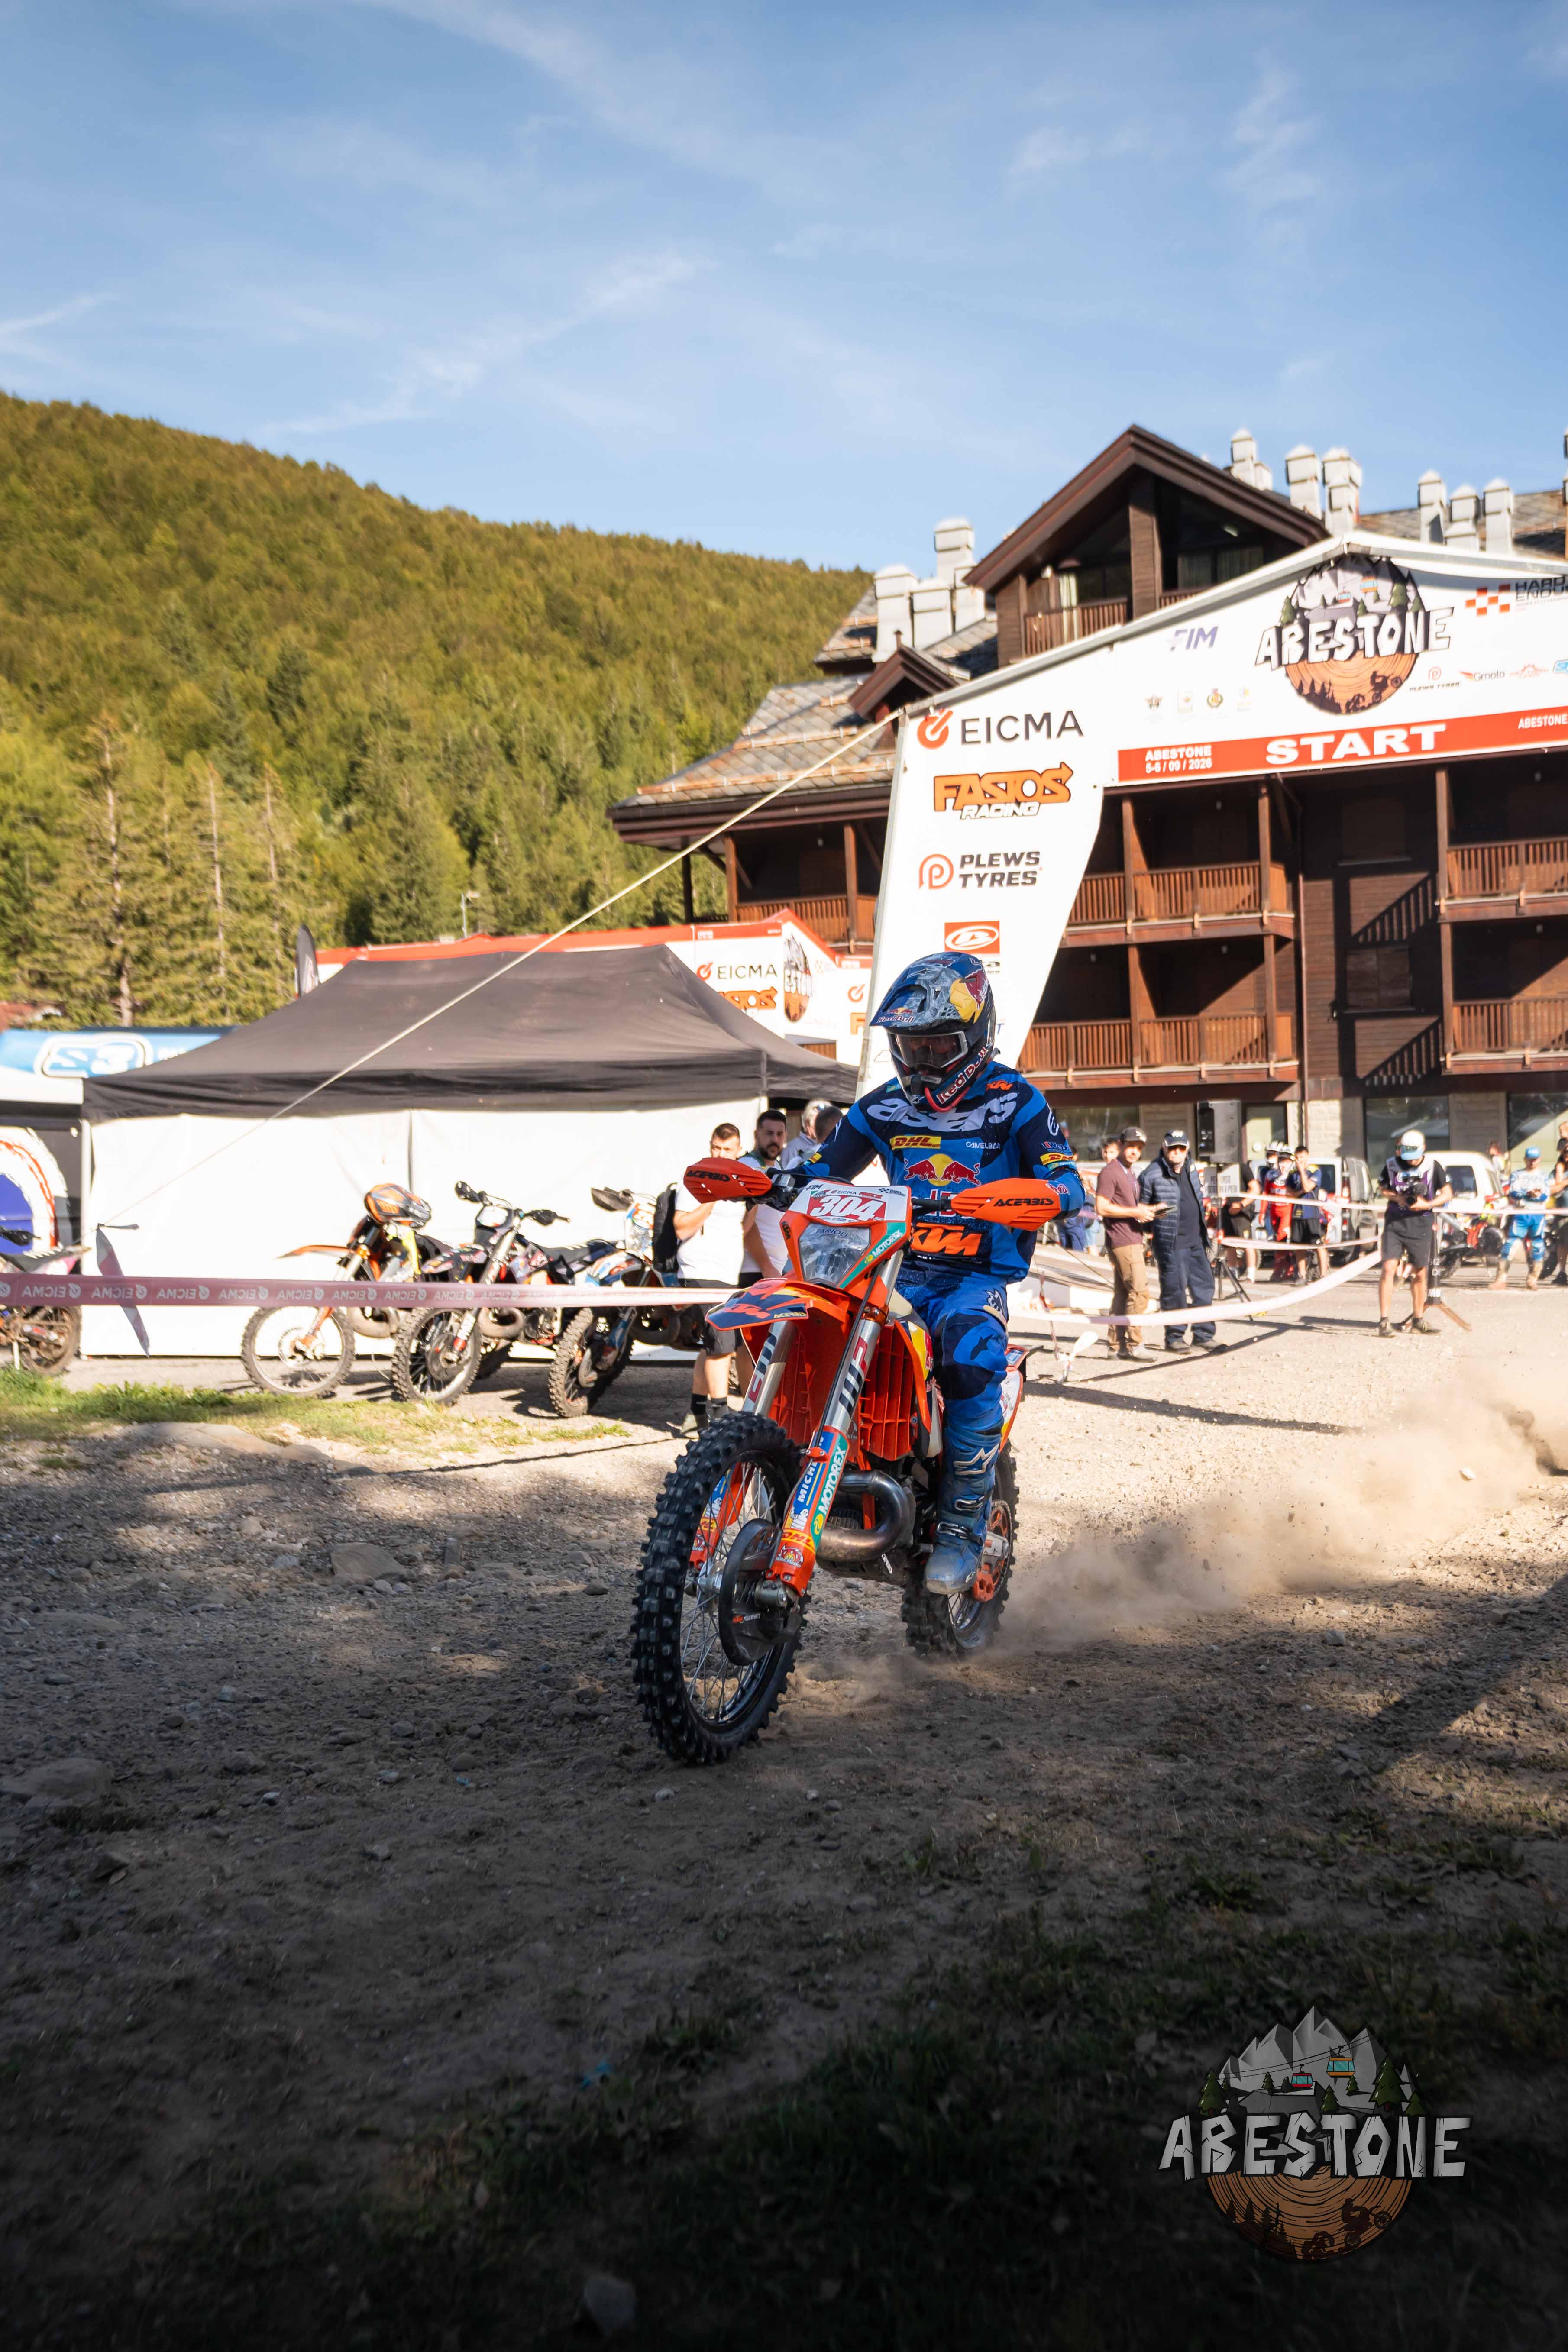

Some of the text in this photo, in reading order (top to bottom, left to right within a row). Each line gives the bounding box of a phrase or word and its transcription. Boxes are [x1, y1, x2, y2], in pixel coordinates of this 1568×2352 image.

[1170, 626, 1219, 652] FIM
[1255, 607, 1454, 670] ABESTONE
[960, 710, 1083, 745] EICMA
[1145, 745, 1212, 762] ABESTONE
[1265, 723, 1446, 766] START
[960, 801, 1040, 820] RACING
[958, 851, 1041, 869] PLEWS
[958, 870, 1038, 889] TYRES
[718, 964, 778, 980] EICMA
[876, 1015, 915, 1024] Red Bull
[894, 1137, 934, 1147] DHL
[686, 1170, 730, 1182] ACERBIS
[810, 1195, 884, 1221] 304
[994, 1198, 1054, 1207] ACERBIS
[816, 1228, 849, 1237] FARIOLI
[911, 1222, 982, 1256] KTM
[872, 1228, 903, 1257] MOTOREX
[818, 1445, 847, 1515] MOTOREX
